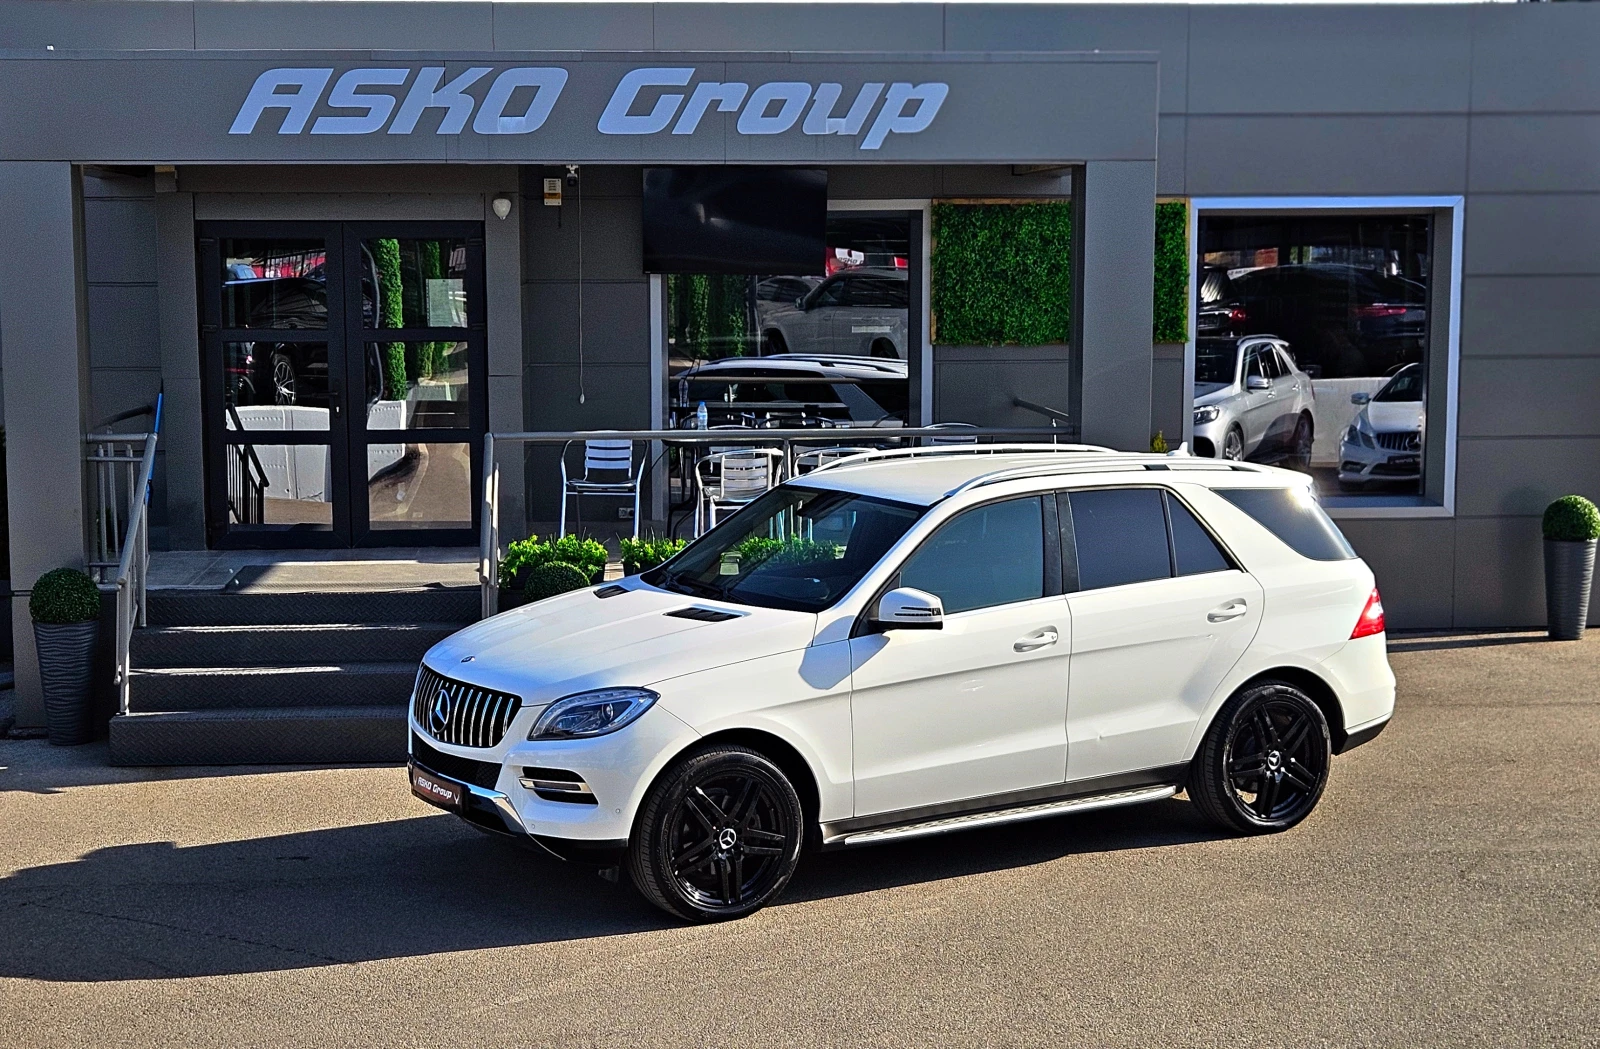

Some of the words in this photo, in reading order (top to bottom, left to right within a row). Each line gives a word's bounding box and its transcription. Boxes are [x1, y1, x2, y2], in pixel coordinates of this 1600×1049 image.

[228, 67, 569, 135] ASKO
[597, 67, 949, 150] Group
[417, 776, 432, 791] ASKO
[432, 784, 453, 800] Group
